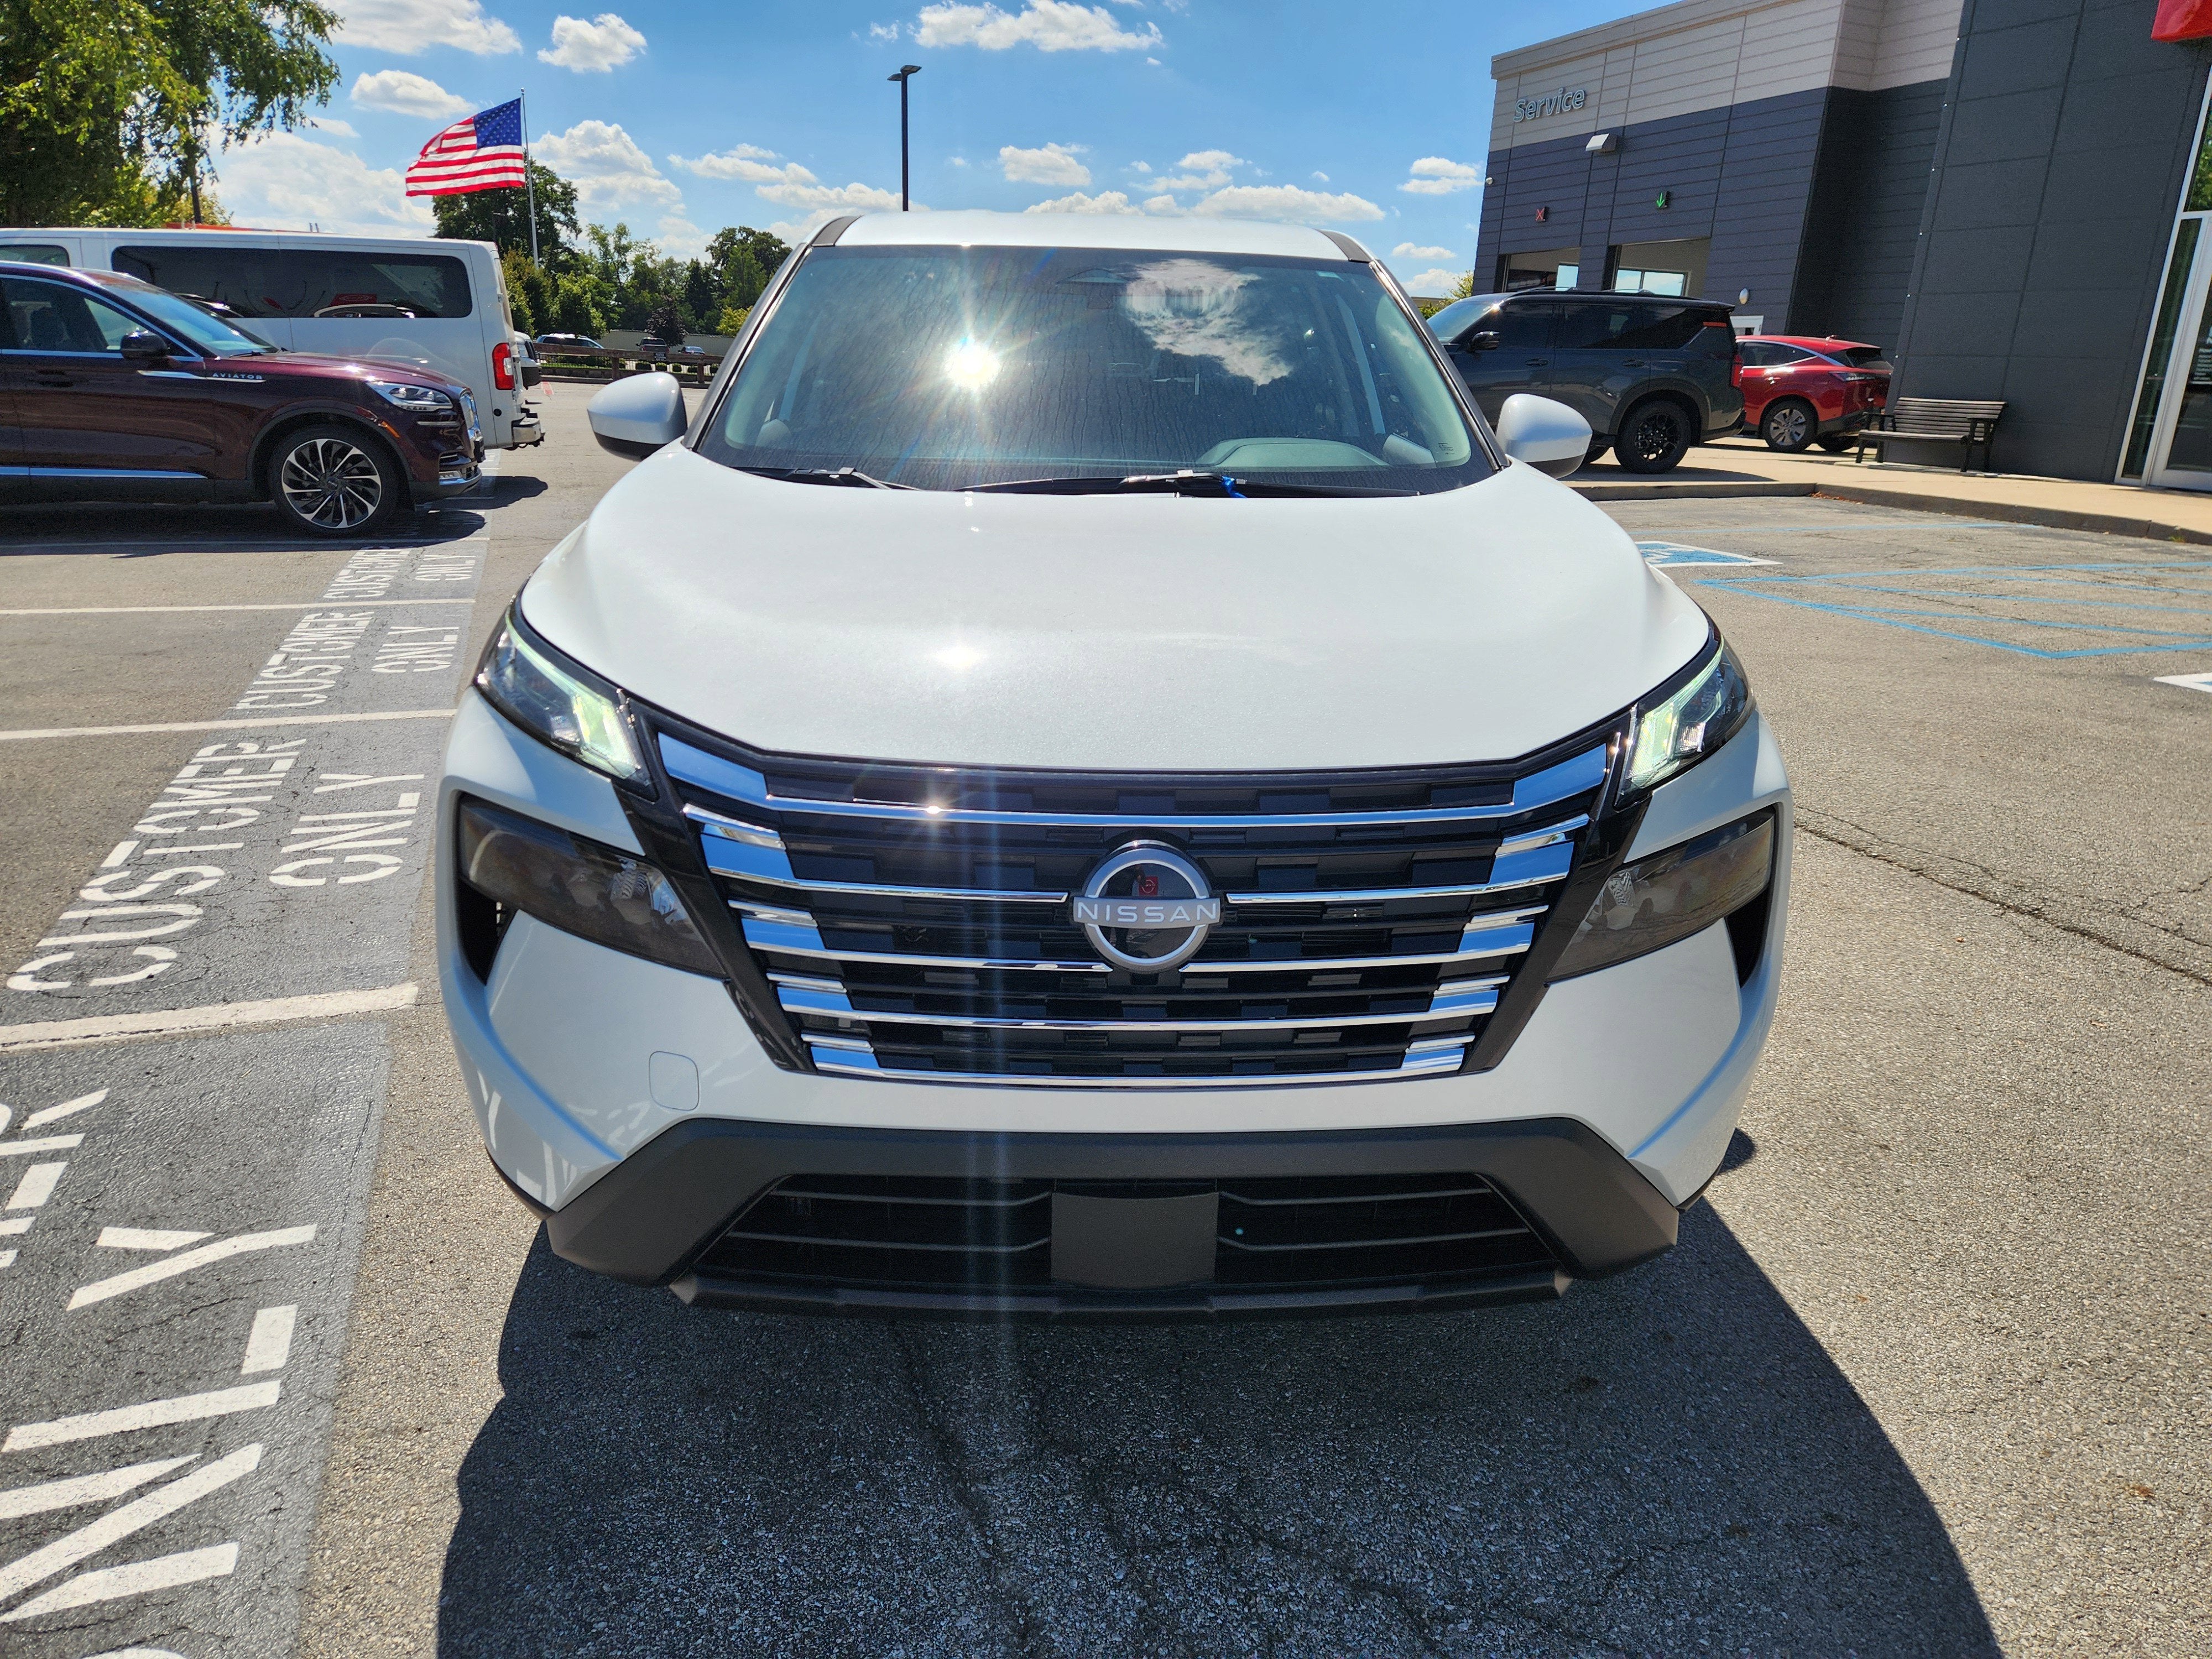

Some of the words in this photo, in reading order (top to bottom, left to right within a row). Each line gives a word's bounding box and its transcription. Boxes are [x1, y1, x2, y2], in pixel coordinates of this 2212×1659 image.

[1514, 87, 1585, 122] Service
[415, 555, 477, 581] ONLY
[236, 611, 374, 709] CUSTOMER
[371, 626, 460, 674] ONLY
[6, 738, 307, 992] CUSTOMER
[269, 774, 425, 886] ONLY
[1077, 902, 1217, 923] NISSAN
[0, 1224, 318, 1659] NLY
